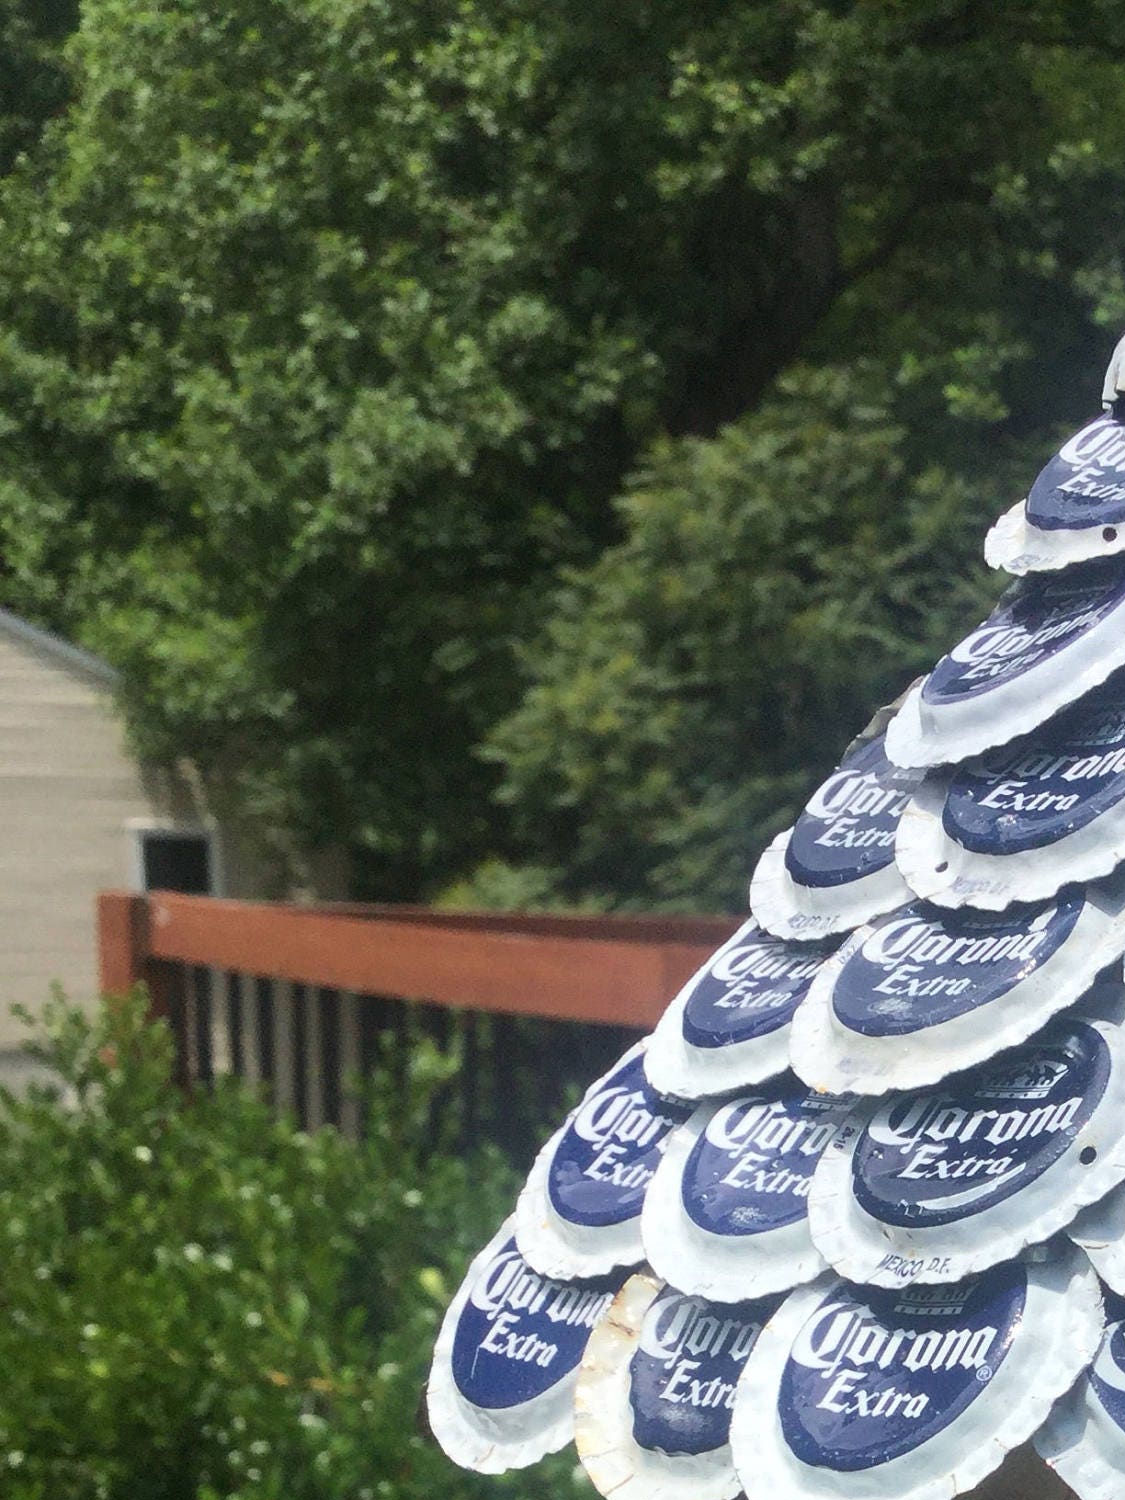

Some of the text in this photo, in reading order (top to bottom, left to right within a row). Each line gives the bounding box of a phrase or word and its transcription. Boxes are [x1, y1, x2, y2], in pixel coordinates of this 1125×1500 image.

[978, 779, 1079, 811] Extra
[862, 917, 1047, 970] Corona
[714, 977, 793, 1009] Extra
[872, 964, 970, 996] Extra
[868, 1097, 1083, 1154] Corona
[584, 1144, 656, 1190] Extr
[897, 1145, 1018, 1180] Extra
[876, 1254, 922, 1278] MEXICO
[480, 1311, 559, 1368] Extra
[791, 1302, 998, 1379] Corona
[816, 1369, 930, 1418] Extra
